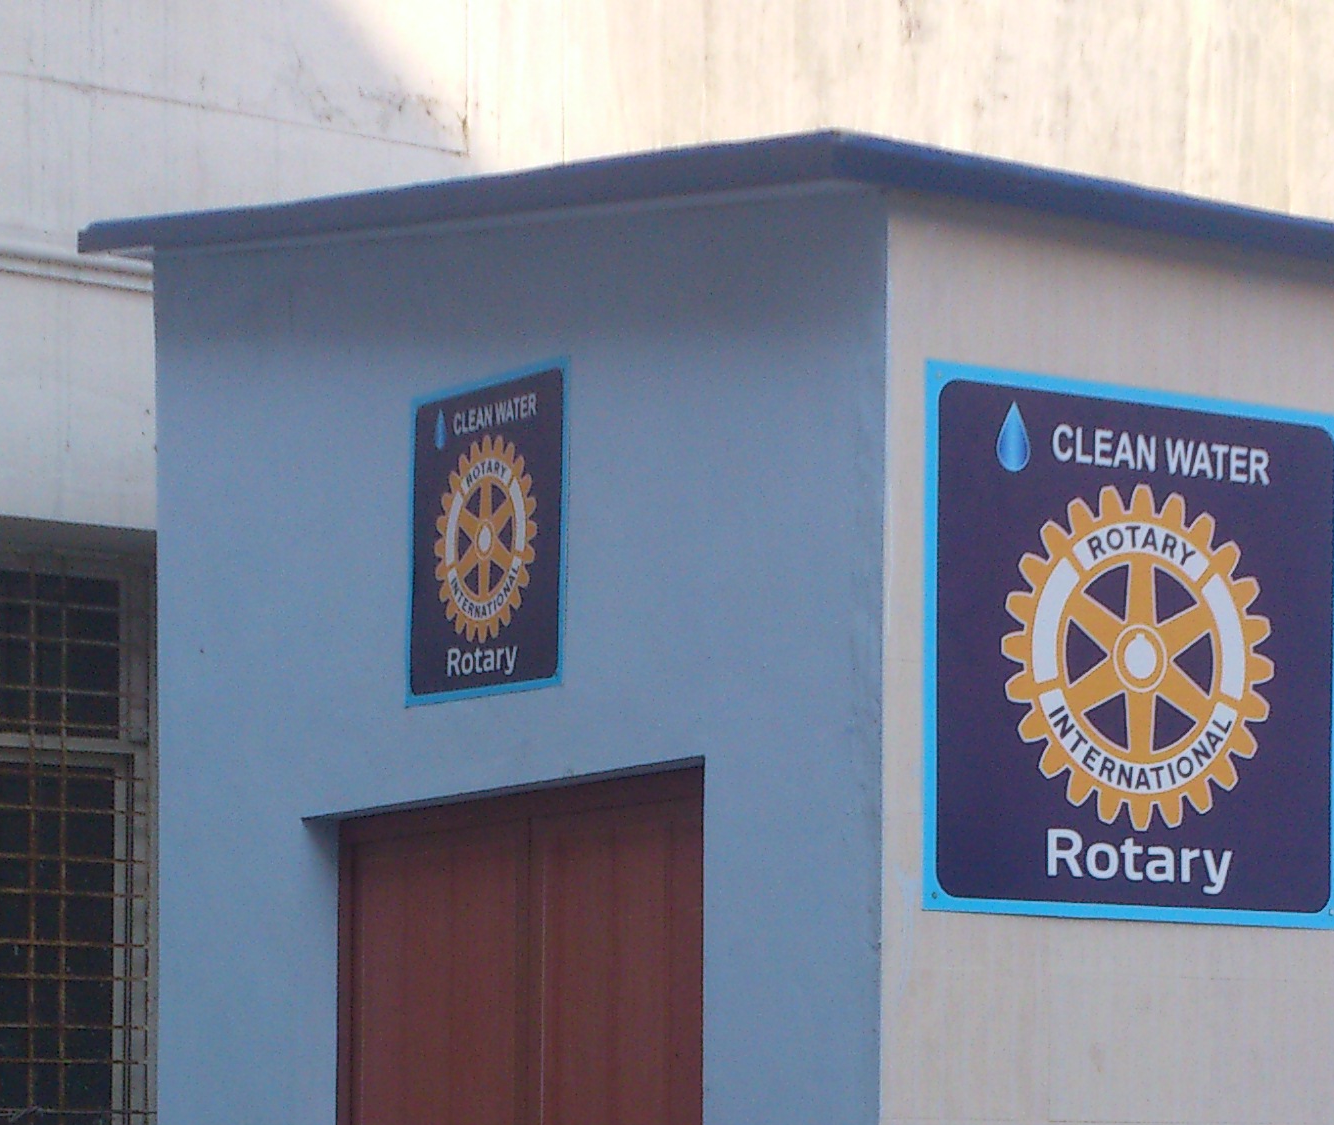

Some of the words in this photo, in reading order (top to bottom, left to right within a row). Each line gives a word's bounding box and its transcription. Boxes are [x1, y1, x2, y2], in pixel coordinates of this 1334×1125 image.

[453, 403, 494, 436] CLEAN
[495, 393, 537, 424] WATER
[466, 462, 507, 487] ROTARY
[1051, 423, 1157, 472] CLEAN
[1165, 438, 1271, 486] WATER
[1086, 525, 1197, 567] ROTARY
[452, 567, 518, 618] INTERNATIONAL
[446, 645, 518, 677] Rotary
[1048, 705, 1233, 791] INTERNATIONAL
[1045, 828, 1234, 895] Rotary
